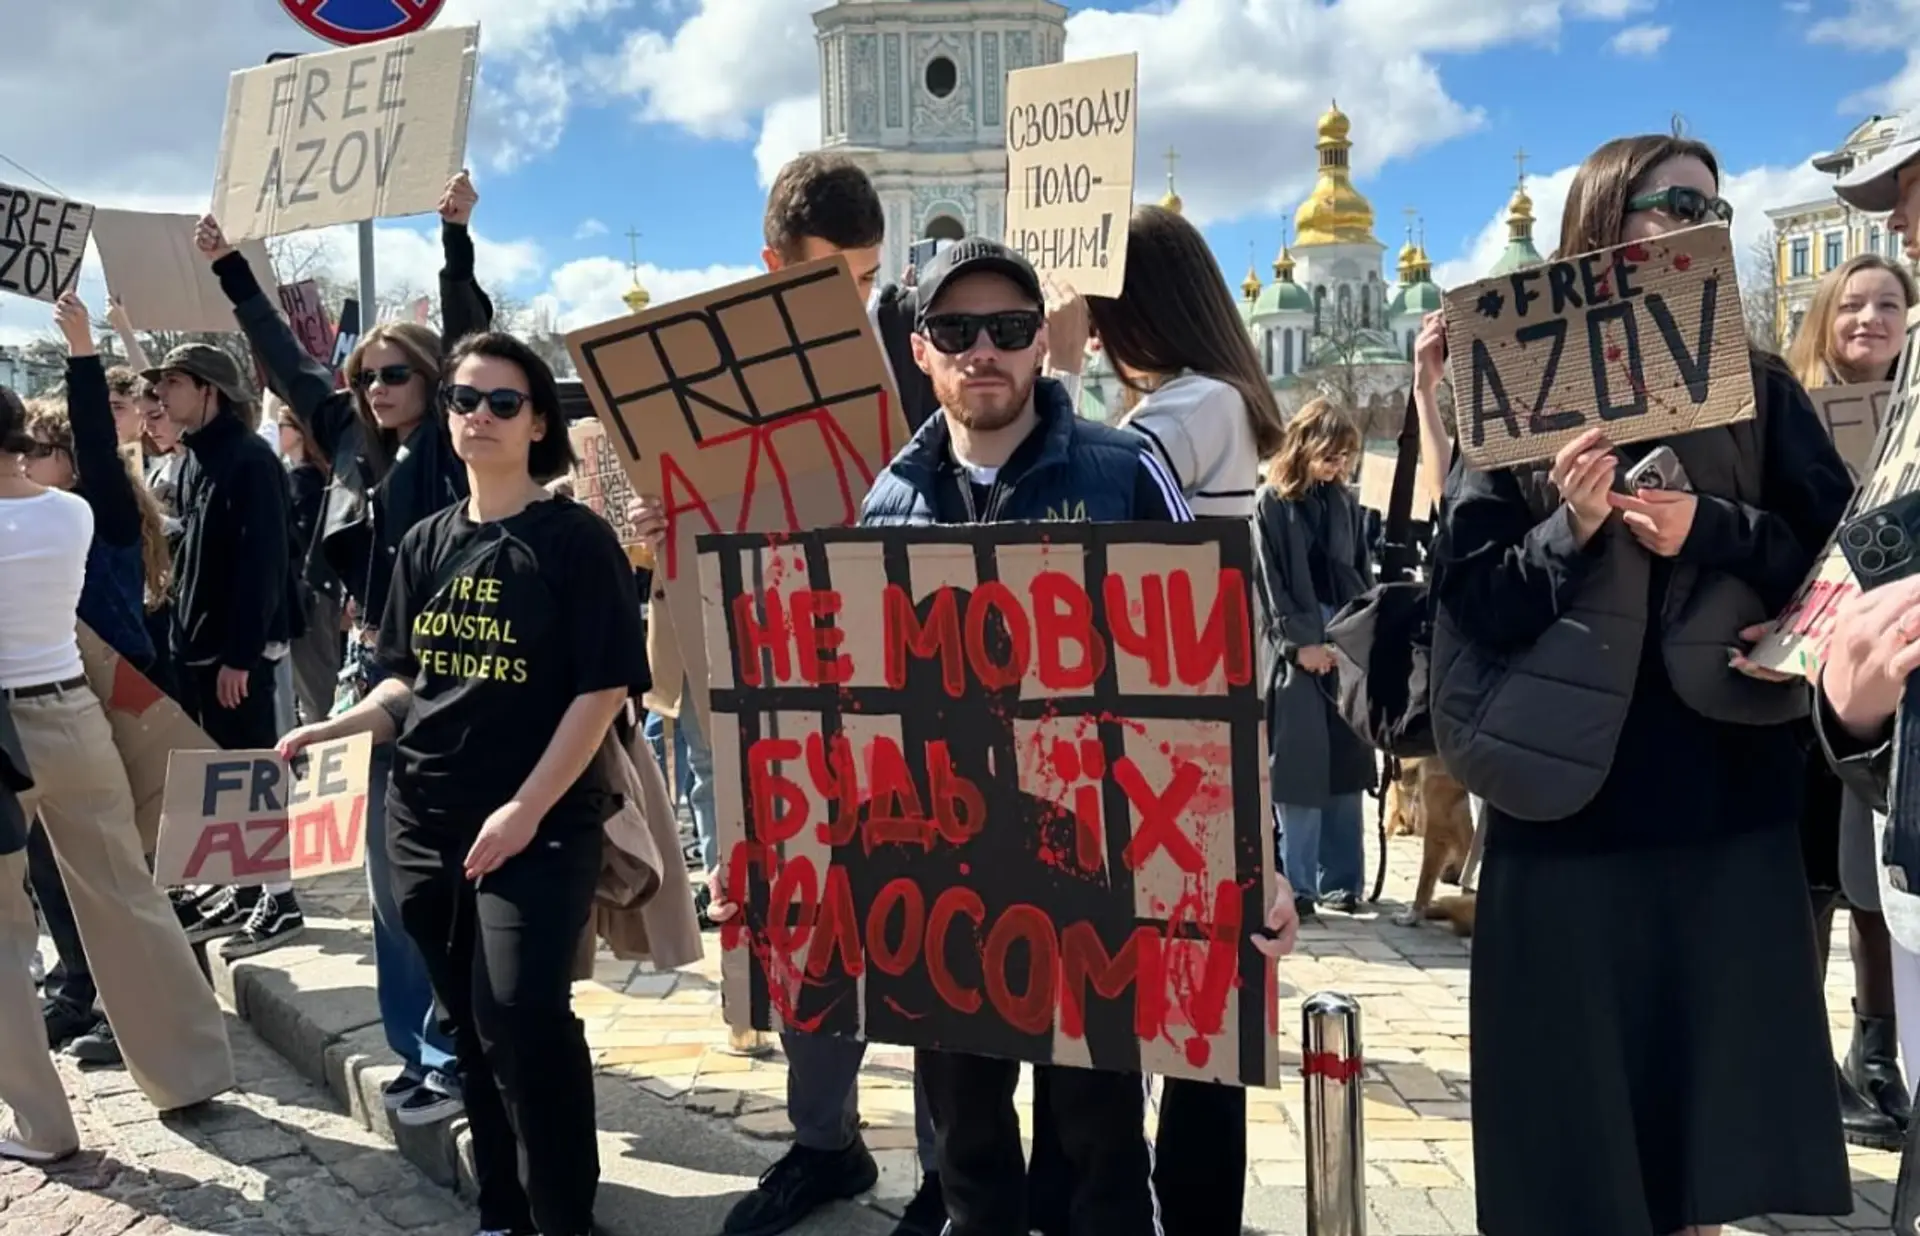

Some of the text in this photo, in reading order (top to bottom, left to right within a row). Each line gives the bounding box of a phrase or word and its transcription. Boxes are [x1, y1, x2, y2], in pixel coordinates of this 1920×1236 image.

[267, 47, 415, 135] FREE
[1009, 88, 1131, 152] СВОБОДУ
[255, 122, 406, 213] AZOV
[1025, 163, 1103, 209] ПОЛО-
[0, 237, 82, 301] ZOV
[580, 265, 883, 463] FREE
[1471, 277, 1718, 446] AZOV
[732, 568, 1252, 697] НЕ МОВЧИ
[203, 742, 349, 818] FREE
[746, 731, 1207, 873] БУДЬ ЇХ
[182, 793, 366, 879] AZOV
[720, 838, 1244, 1069] ГОЛОСОМ!
